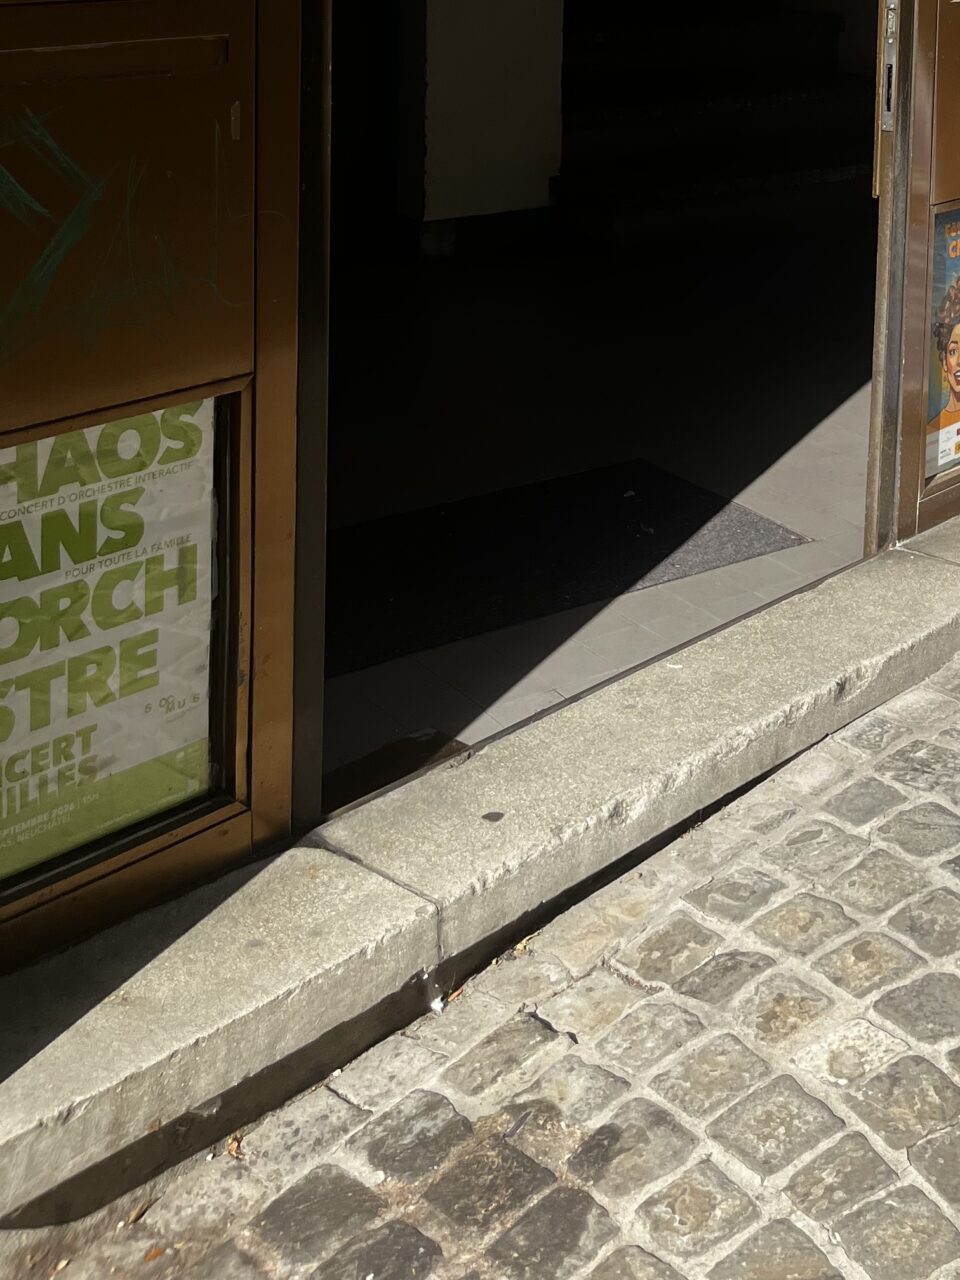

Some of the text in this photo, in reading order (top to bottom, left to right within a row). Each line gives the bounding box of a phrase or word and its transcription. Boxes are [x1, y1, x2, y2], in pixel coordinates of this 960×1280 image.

[57, 478, 133, 507] D'ORCHESTRE
[134, 460, 194, 486] INTERACTIF
[0, 486, 146, 582] ANS
[64, 562, 97, 580] POUR
[97, 552, 134, 571] TOUTE
[135, 547, 149, 560] LA
[0, 723, 98, 787] CERT
[0, 755, 98, 818] ILLES
